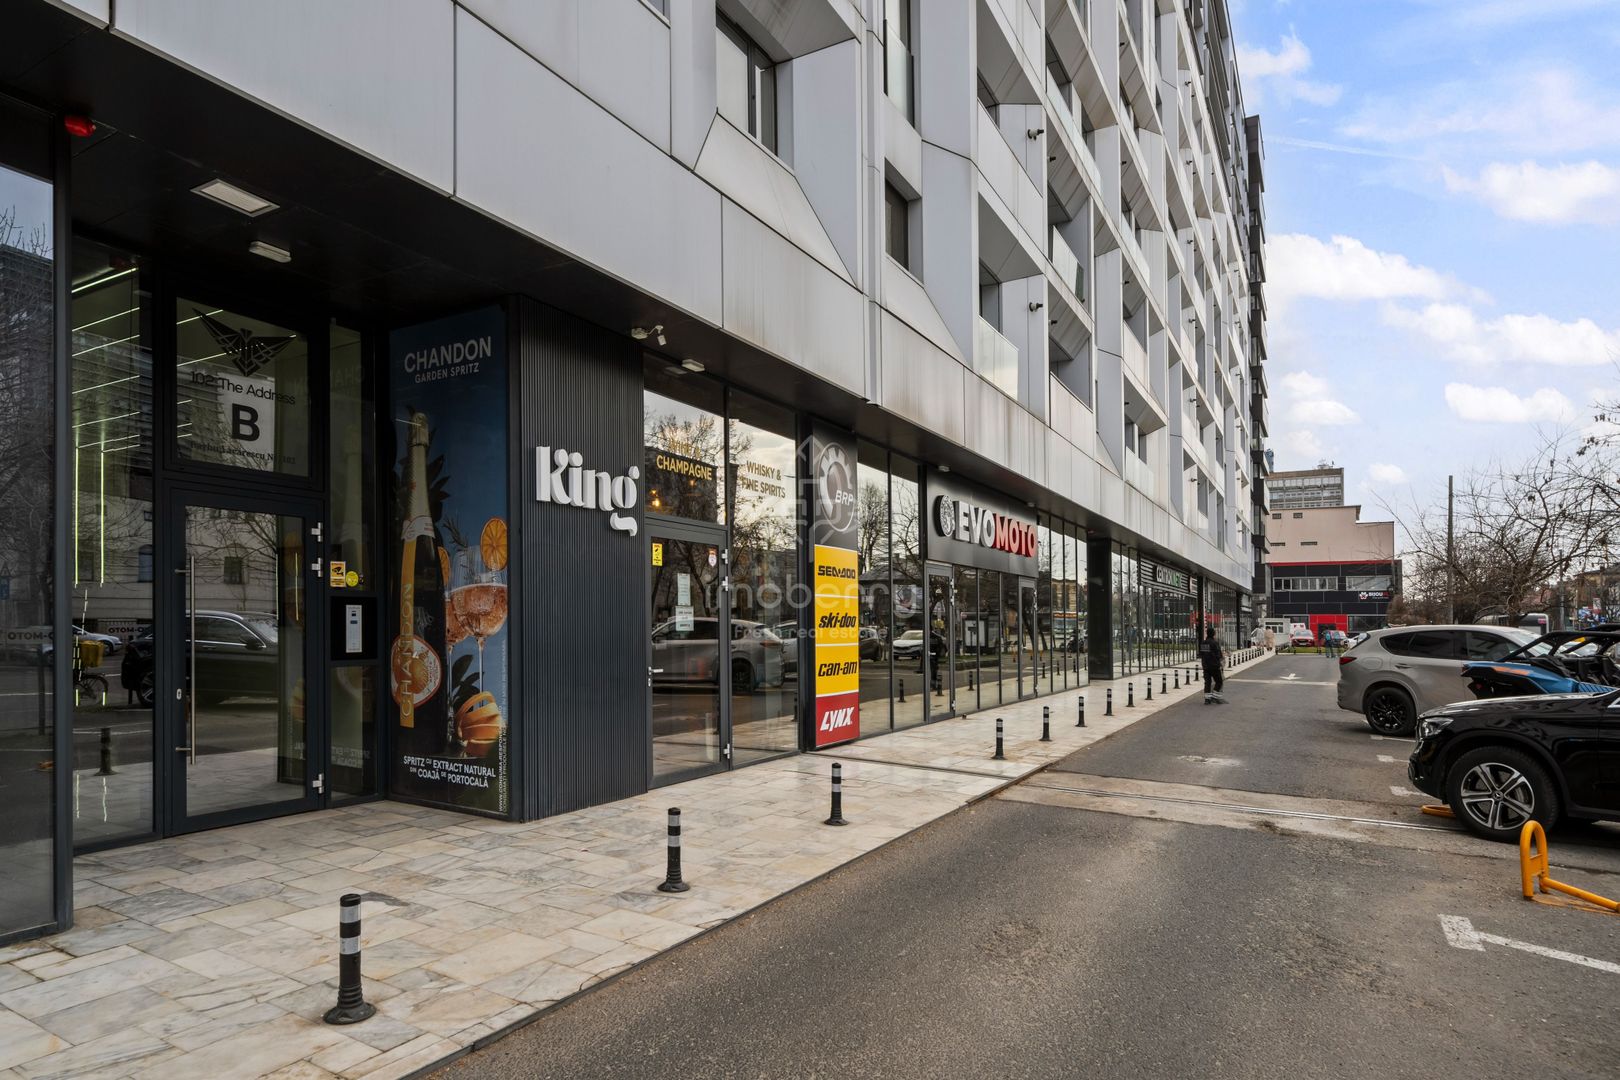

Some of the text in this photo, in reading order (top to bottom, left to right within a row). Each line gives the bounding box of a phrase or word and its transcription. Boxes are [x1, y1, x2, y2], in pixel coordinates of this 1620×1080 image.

[404, 336, 492, 373] CHANDON
[415, 363, 480, 384] GARDEN SPRITZ
[218, 377, 243, 393] The
[247, 384, 296, 405] Address
[231, 403, 260, 442] B
[656, 455, 713, 481] CHAMPAGNE
[746, 460, 782, 481] WHISKY &
[536, 446, 640, 537] King
[760, 481, 786, 499] SPIRITS
[835, 490, 854, 506] BRP
[956, 501, 1036, 558] EVOMOTO
[401, 584, 413, 717] CHANDON
[820, 706, 855, 732] LYNX
[403, 755, 425, 767] SPRITZ
[433, 759, 463, 773] EXTRACT
[464, 765, 496, 778] NATURAL
